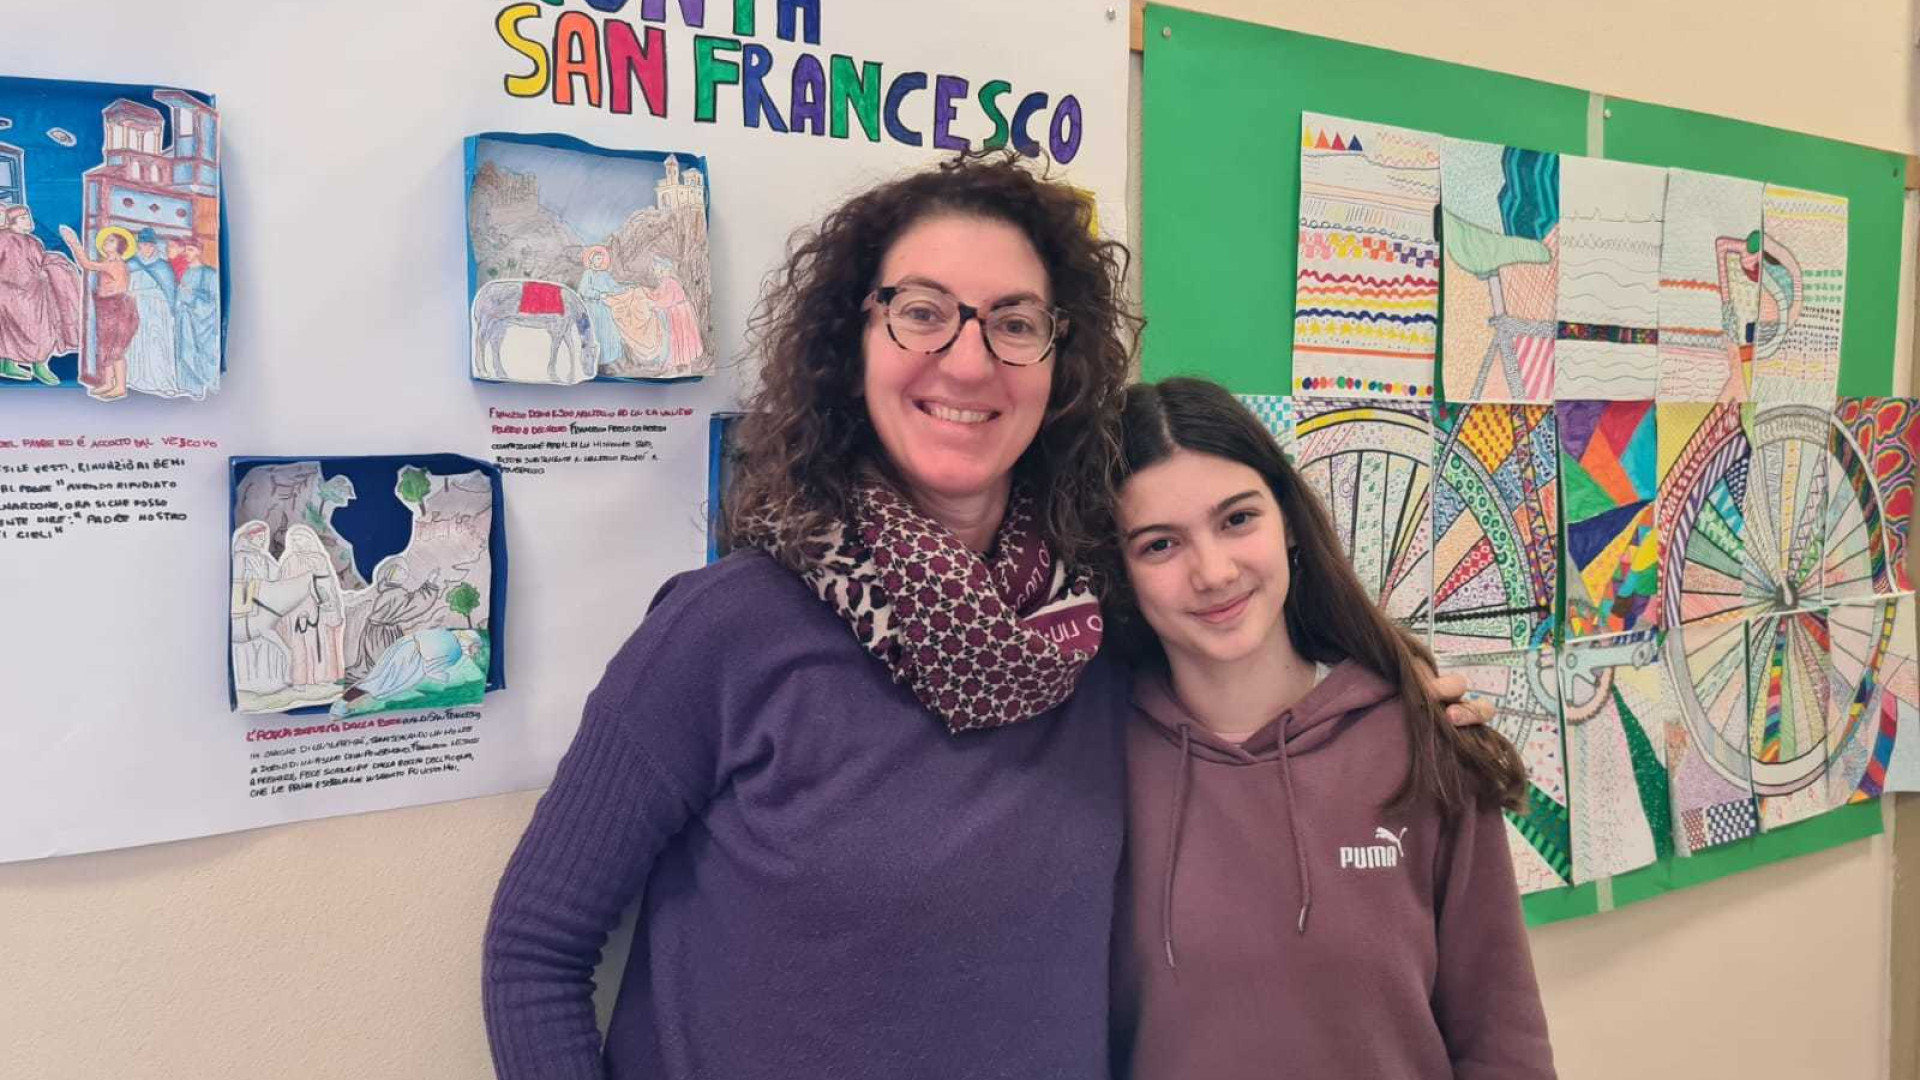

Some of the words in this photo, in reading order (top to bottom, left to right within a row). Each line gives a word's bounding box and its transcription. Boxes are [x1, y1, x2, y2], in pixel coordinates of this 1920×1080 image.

[495, 3, 667, 119] SAN
[693, 35, 1083, 164] FRANCESCO
[162, 436, 218, 448] VESCOVO
[139, 512, 187, 521] NOSTRO
[1340, 846, 1397, 868] PUMA
